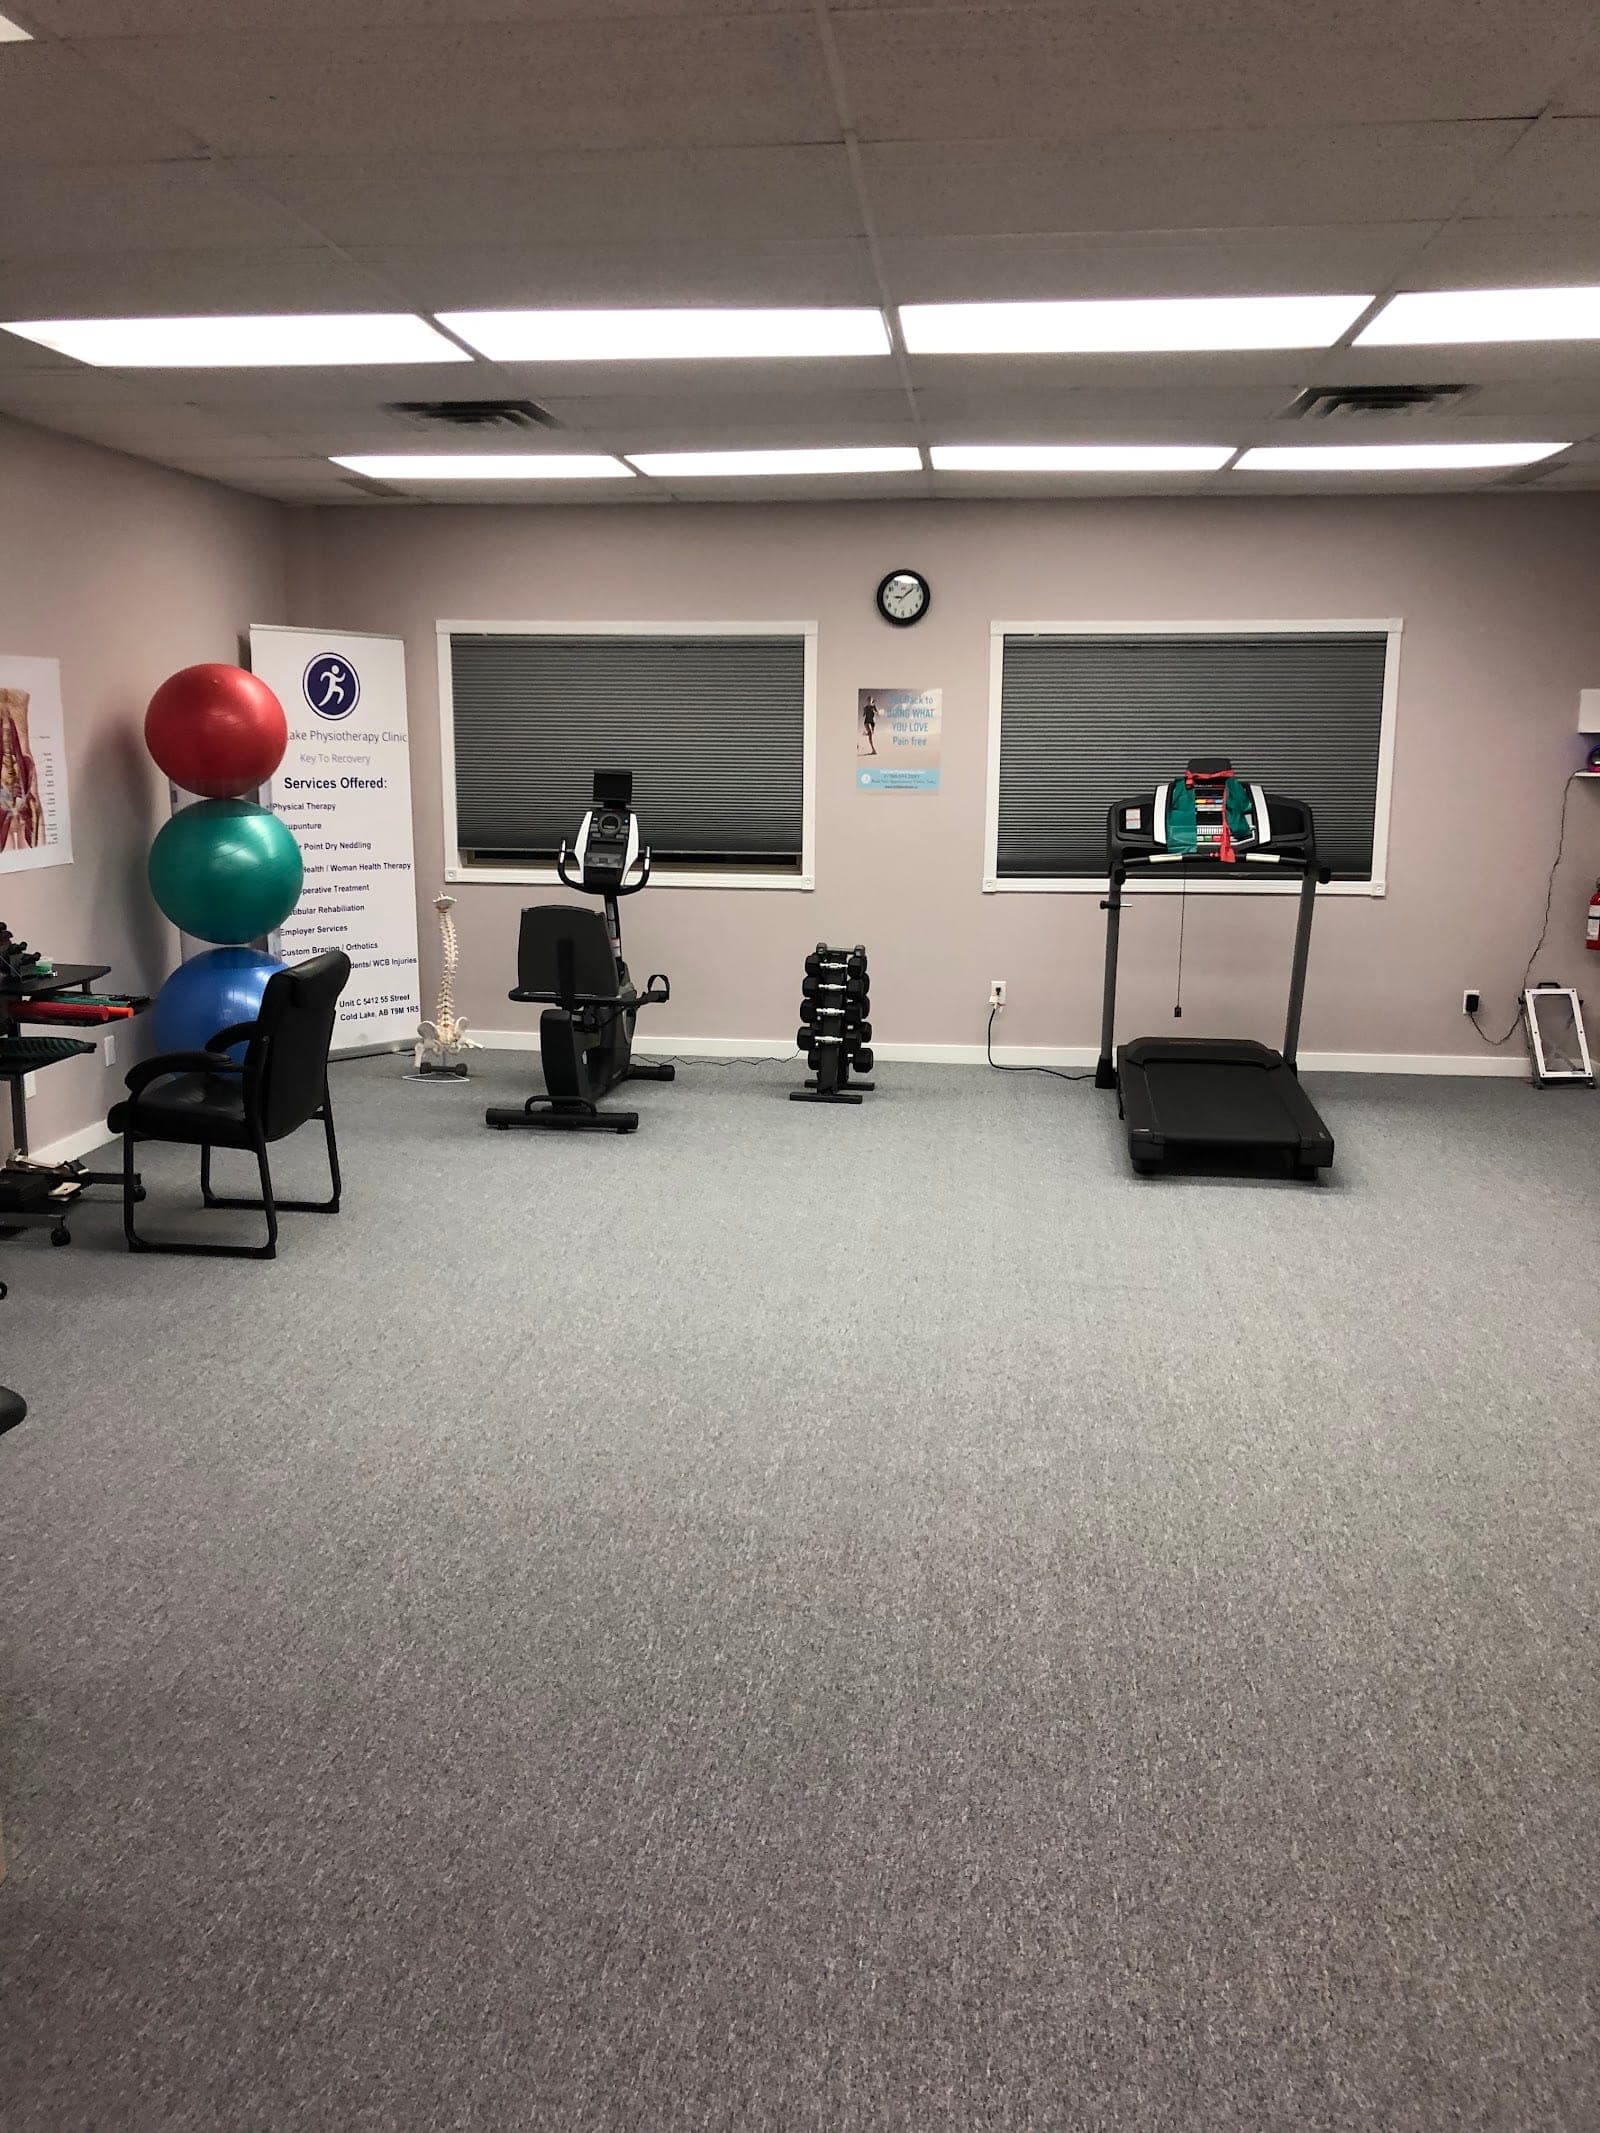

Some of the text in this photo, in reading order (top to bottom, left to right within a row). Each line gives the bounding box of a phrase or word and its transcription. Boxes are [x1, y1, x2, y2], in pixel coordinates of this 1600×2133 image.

[911, 707, 934, 718] WHAT
[891, 721, 929, 732] YOU LOVE
[288, 730, 408, 743] ake Physiotherapy Clinic
[892, 735, 927, 746] Pain free
[300, 754, 371, 764] Key To Recovery
[284, 777, 388, 789] Services Offered:
[272, 802, 336, 812] Physical Therapy
[325, 842, 337, 850] Dry
[339, 842, 371, 850] Neddling
[359, 863, 381, 871] Health
[383, 862, 411, 871] Therapy
[333, 884, 369, 892] Treatment
[280, 925, 348, 937] Employer Services
[281, 947, 310, 957] Custom
[346, 943, 378, 951] Orthotics
[391, 957, 417, 967] Injuries
[339, 1000, 355, 1008] Unit
[390, 994, 410, 1003] Street
[378, 1009, 389, 1017] AB
[390, 1007, 405, 1015] T9M
[406, 1005, 419, 1013] 1R5
